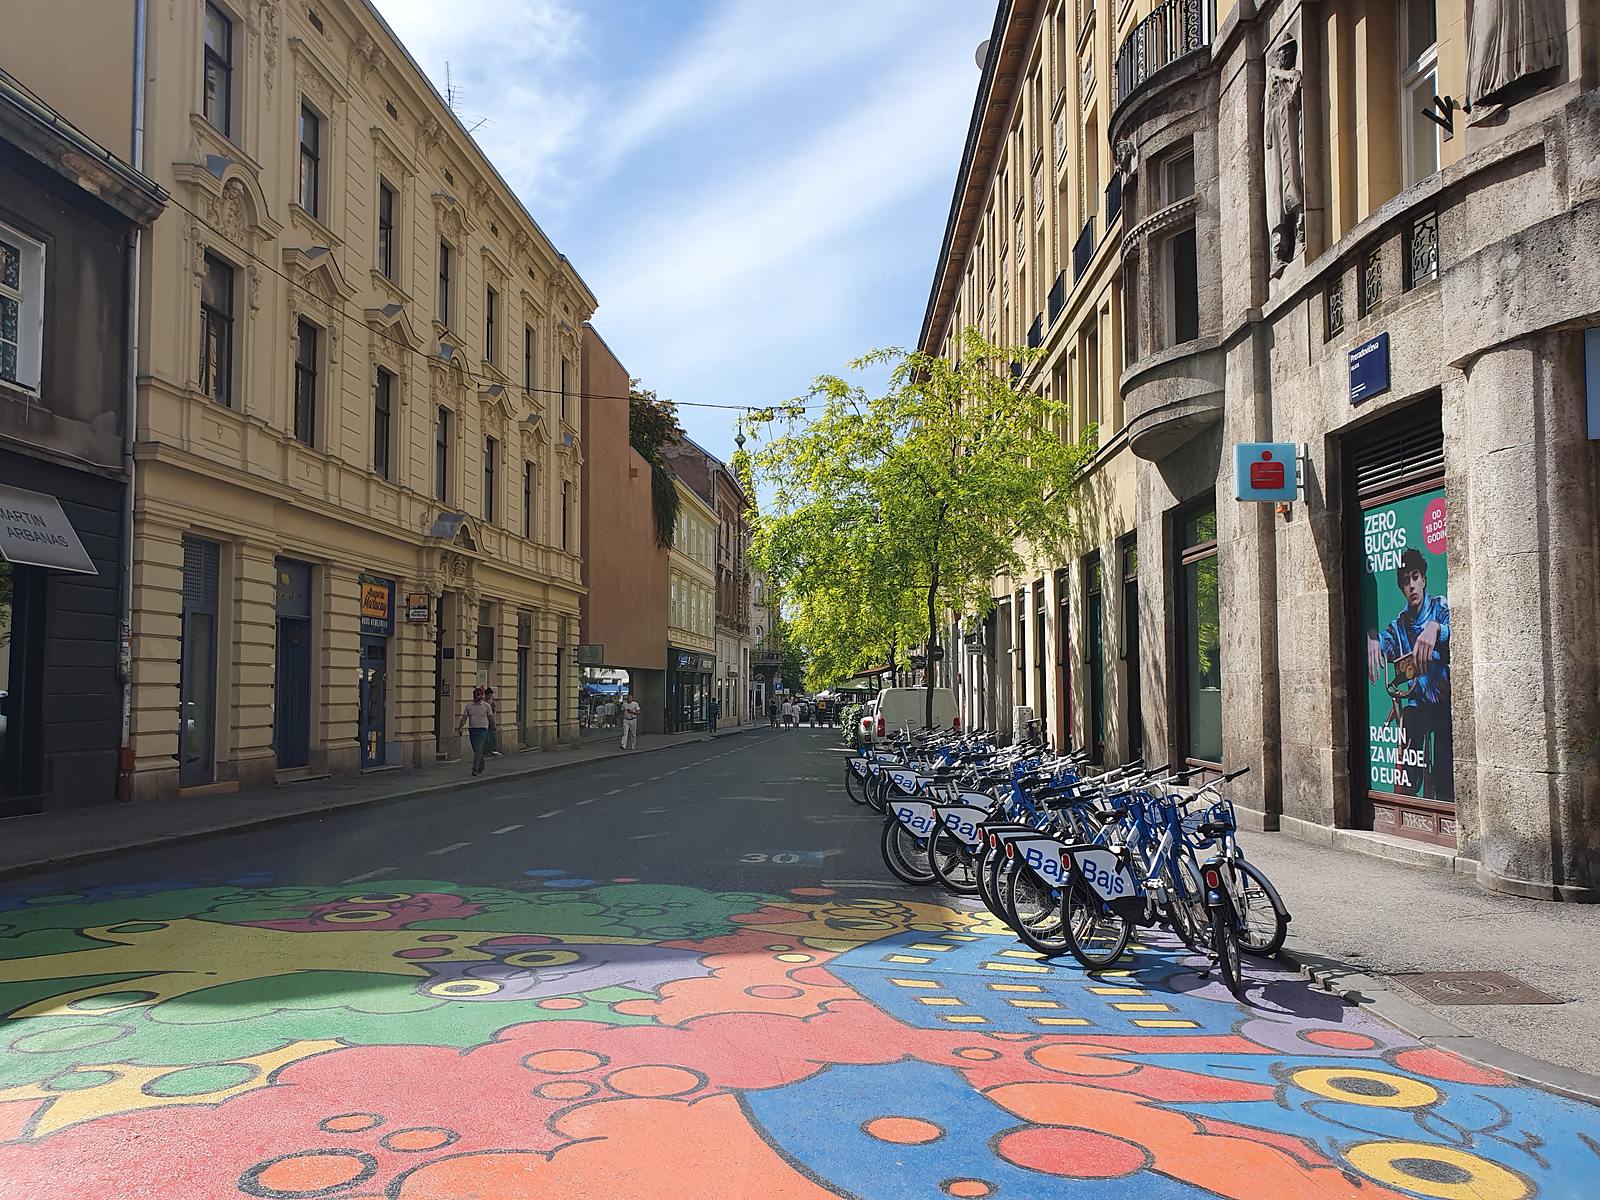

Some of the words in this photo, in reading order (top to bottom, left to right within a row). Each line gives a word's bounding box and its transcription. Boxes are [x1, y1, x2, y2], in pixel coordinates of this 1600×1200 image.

[0, 507, 46, 528] MARTIN
[1364, 510, 1396, 535] ZERO
[1432, 509, 1442, 520] OD
[7, 526, 69, 547] ARBANAS
[1425, 524, 1433, 534] 18
[1433, 521, 1443, 532] DO
[1427, 529, 1447, 544] GODIN
[1365, 528, 1407, 555] BUCKS
[1366, 550, 1406, 574] GIVEN.
[1370, 721, 1407, 744] RAČUN
[854, 761, 867, 774] Ba
[1370, 746, 1385, 762] ZA
[1386, 748, 1427, 768] MLADE.
[893, 774, 916, 791] Baj
[1380, 767, 1412, 787] EURA.
[898, 807, 934, 833] Baj
[945, 813, 978, 840] Baj
[740, 853, 800, 863] 30
[1025, 848, 1063, 882] Baj
[1083, 858, 1124, 895] Bajs
